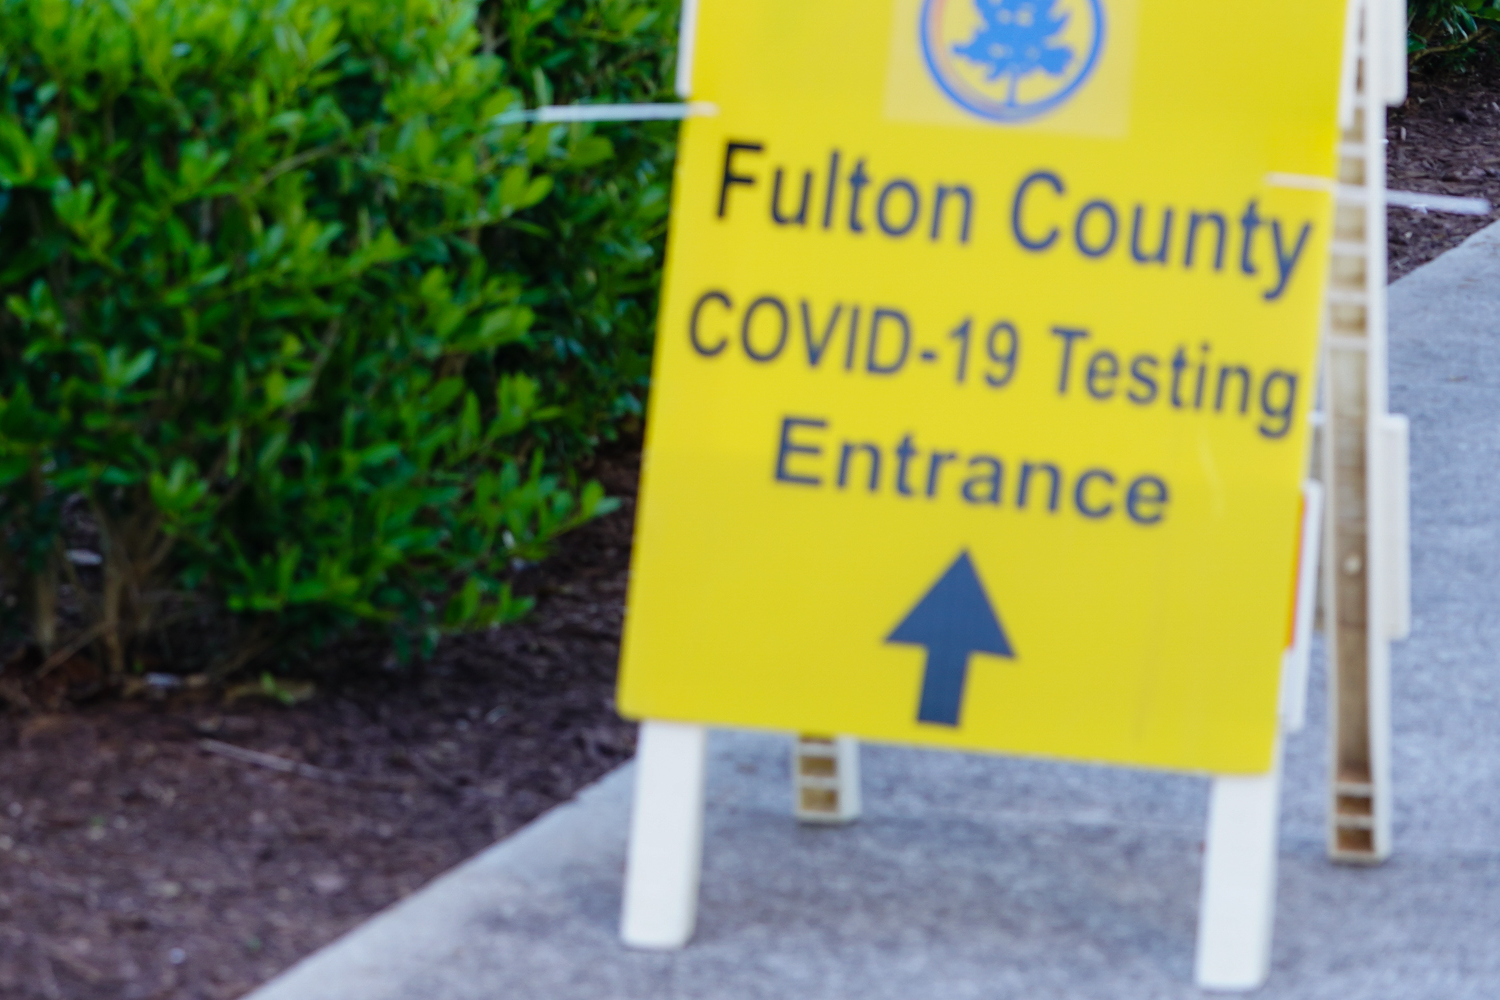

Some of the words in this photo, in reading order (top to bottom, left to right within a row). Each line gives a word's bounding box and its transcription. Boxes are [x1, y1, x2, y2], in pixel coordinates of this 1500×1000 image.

[714, 137, 974, 245] Fulton
[1009, 168, 1313, 303] County
[686, 287, 1020, 390] COVID-19
[1049, 324, 1300, 441] Testing
[771, 414, 1171, 527] Entrance
